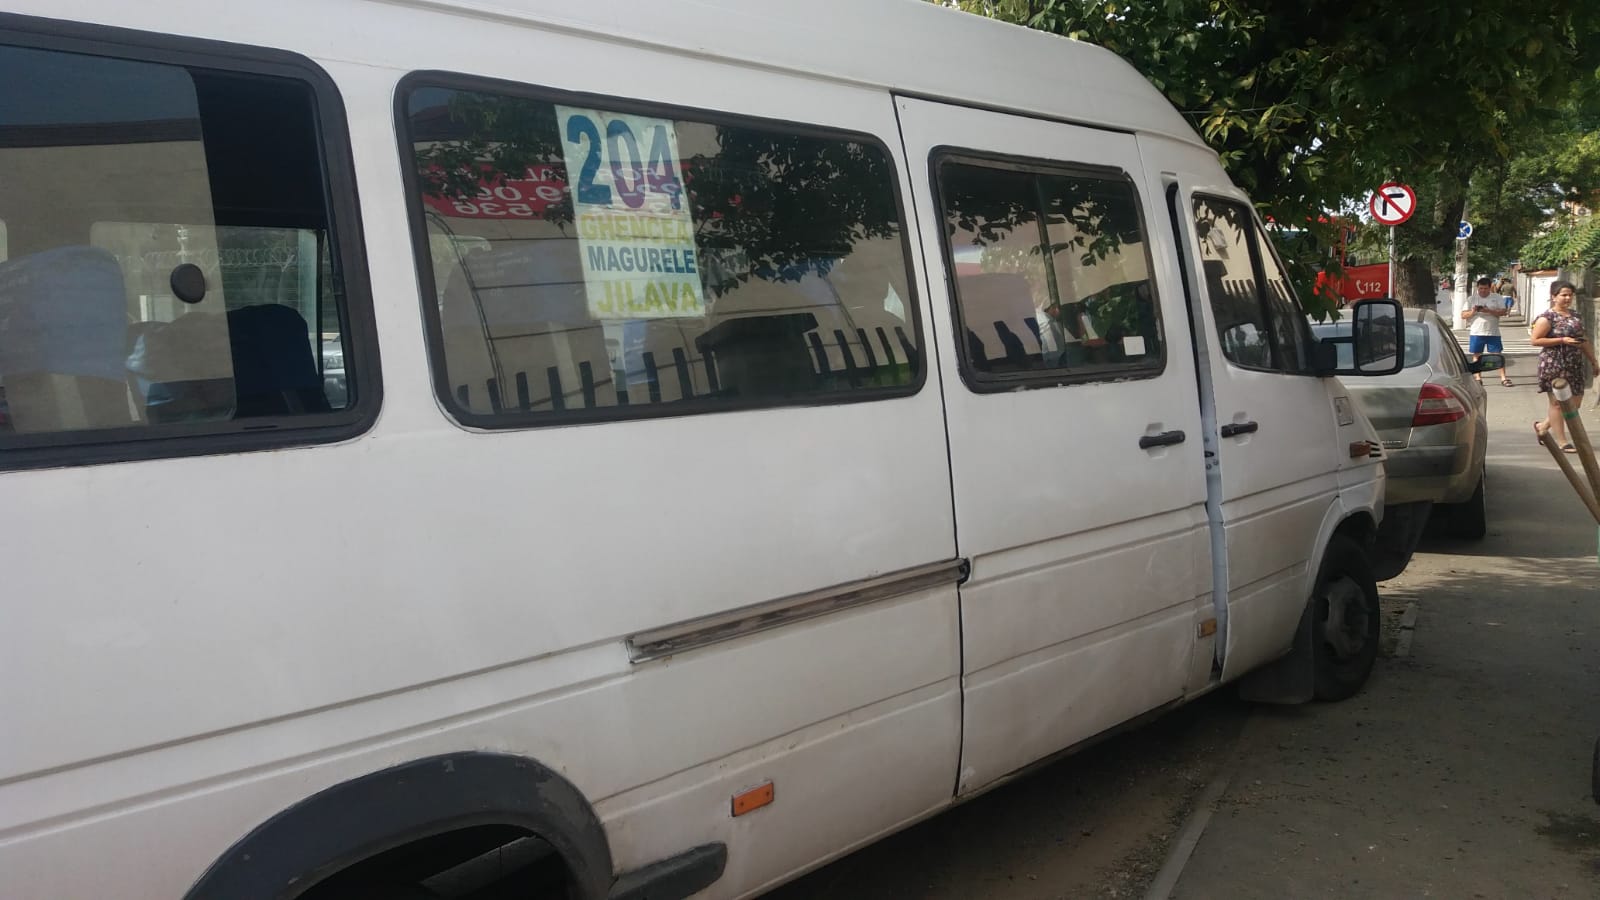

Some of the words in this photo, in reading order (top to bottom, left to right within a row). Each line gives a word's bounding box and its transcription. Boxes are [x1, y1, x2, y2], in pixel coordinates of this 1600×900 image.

[567, 114, 683, 210] 204
[580, 215, 693, 244] GHENCEA
[587, 246, 697, 274] MAGURELE
[596, 280, 699, 313] JILAVA
[1363, 282, 1381, 292] 112
